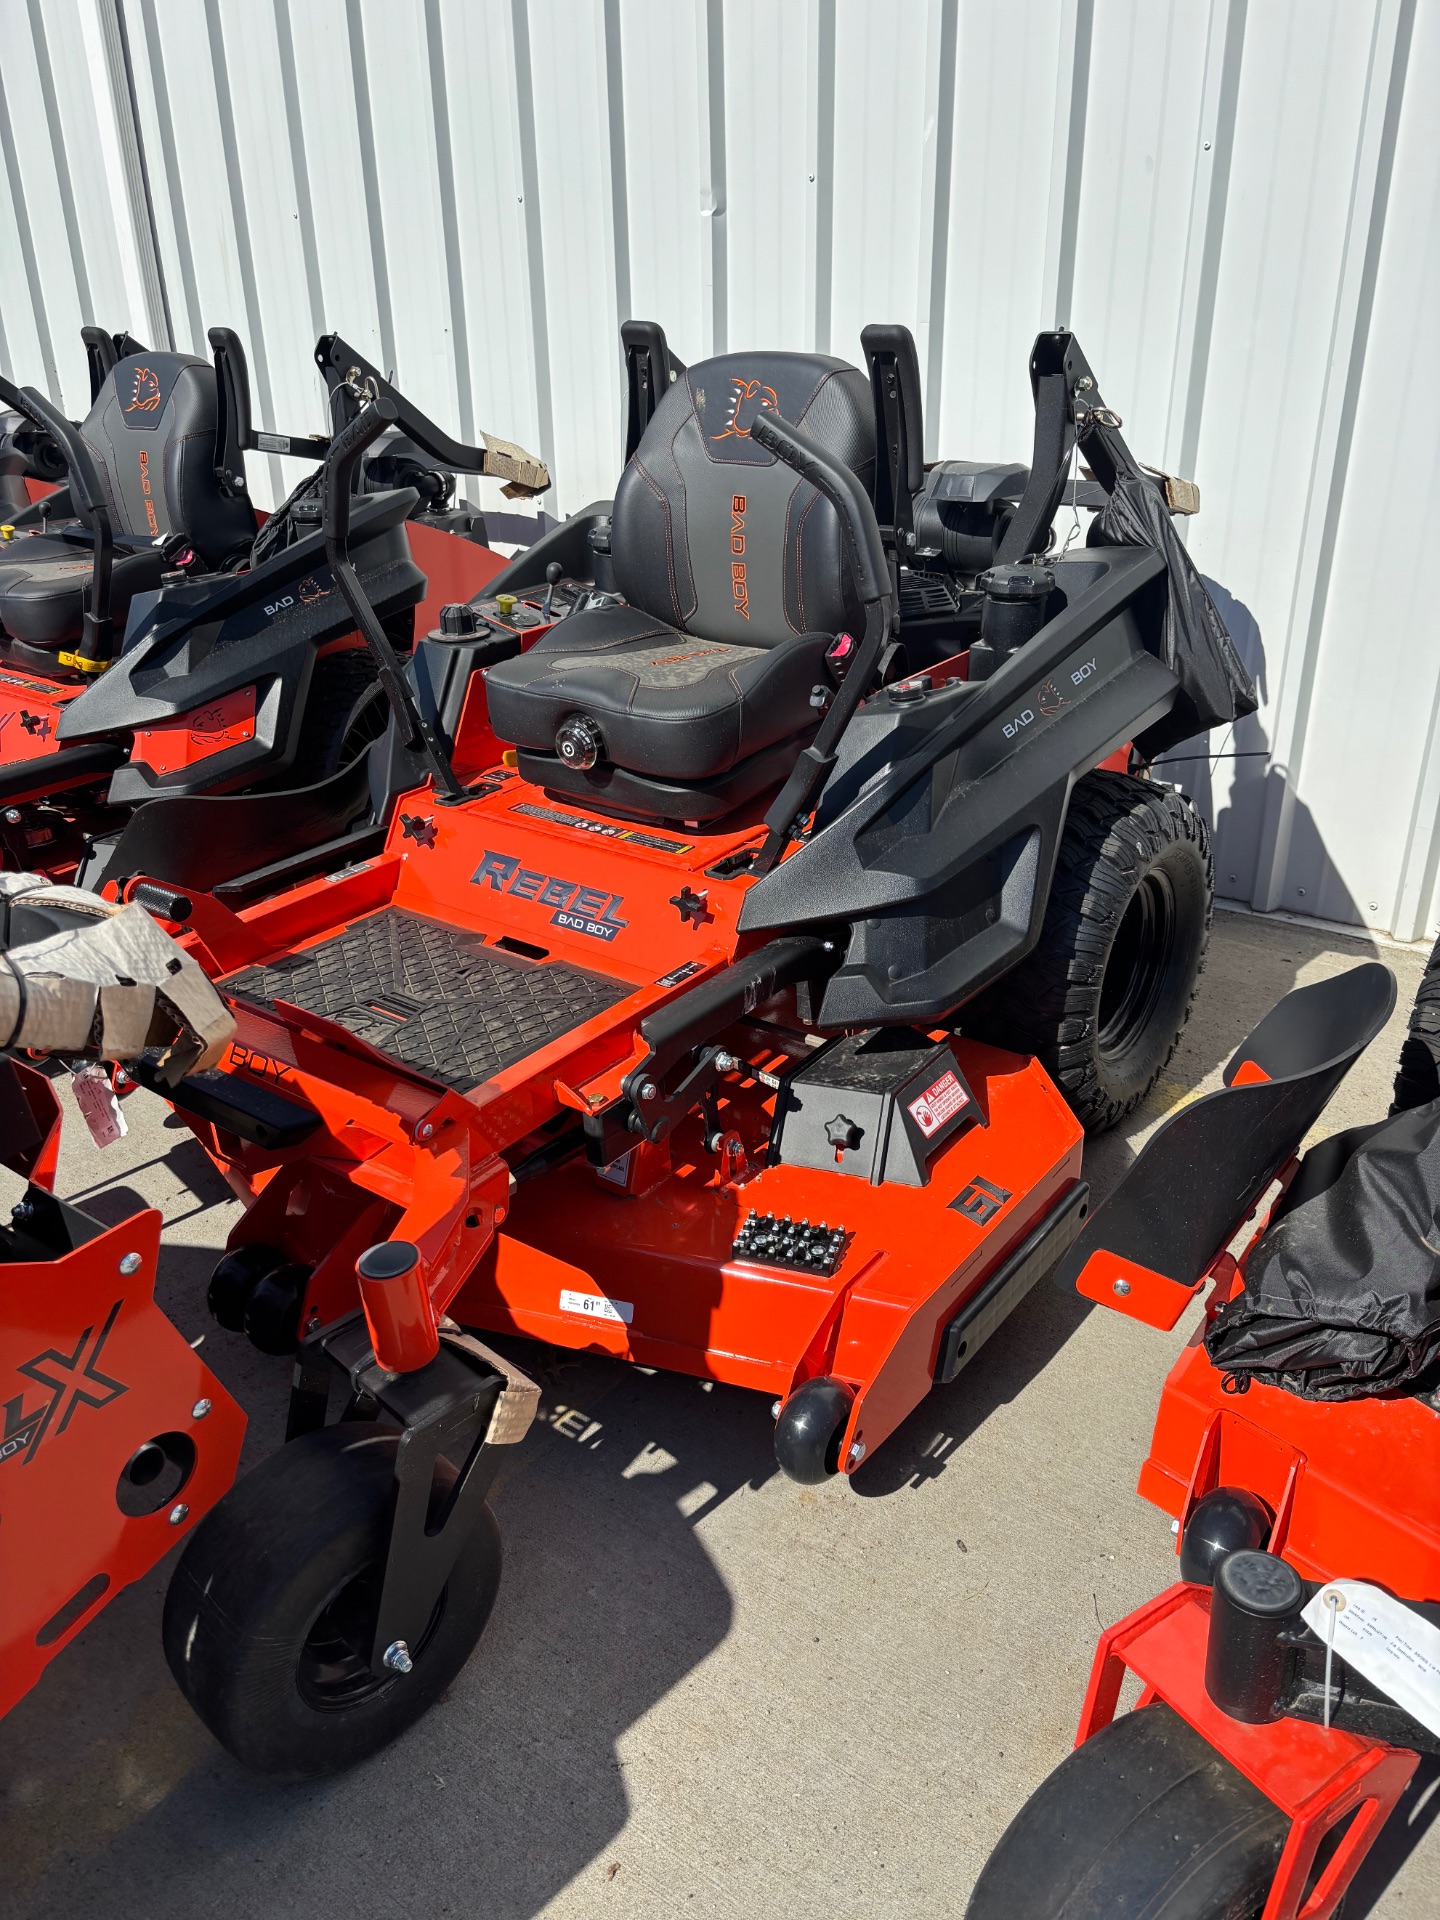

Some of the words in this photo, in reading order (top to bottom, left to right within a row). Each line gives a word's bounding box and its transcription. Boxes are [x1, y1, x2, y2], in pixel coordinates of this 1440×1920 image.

[139, 450, 152, 495] BAD
[731, 494, 747, 556] BAD
[263, 595, 295, 616] BAD
[731, 561, 750, 621] BOY
[1002, 709, 1035, 739] BAD
[1070, 658, 1097, 686] BOY
[470, 850, 630, 928] REBEL
[557, 913, 585, 929] BAD
[586, 923, 614, 938] BOY
[229, 1042, 292, 1085] BOY
[930, 1074, 955, 1096] DANGER
[946, 1174, 1014, 1228] 61
